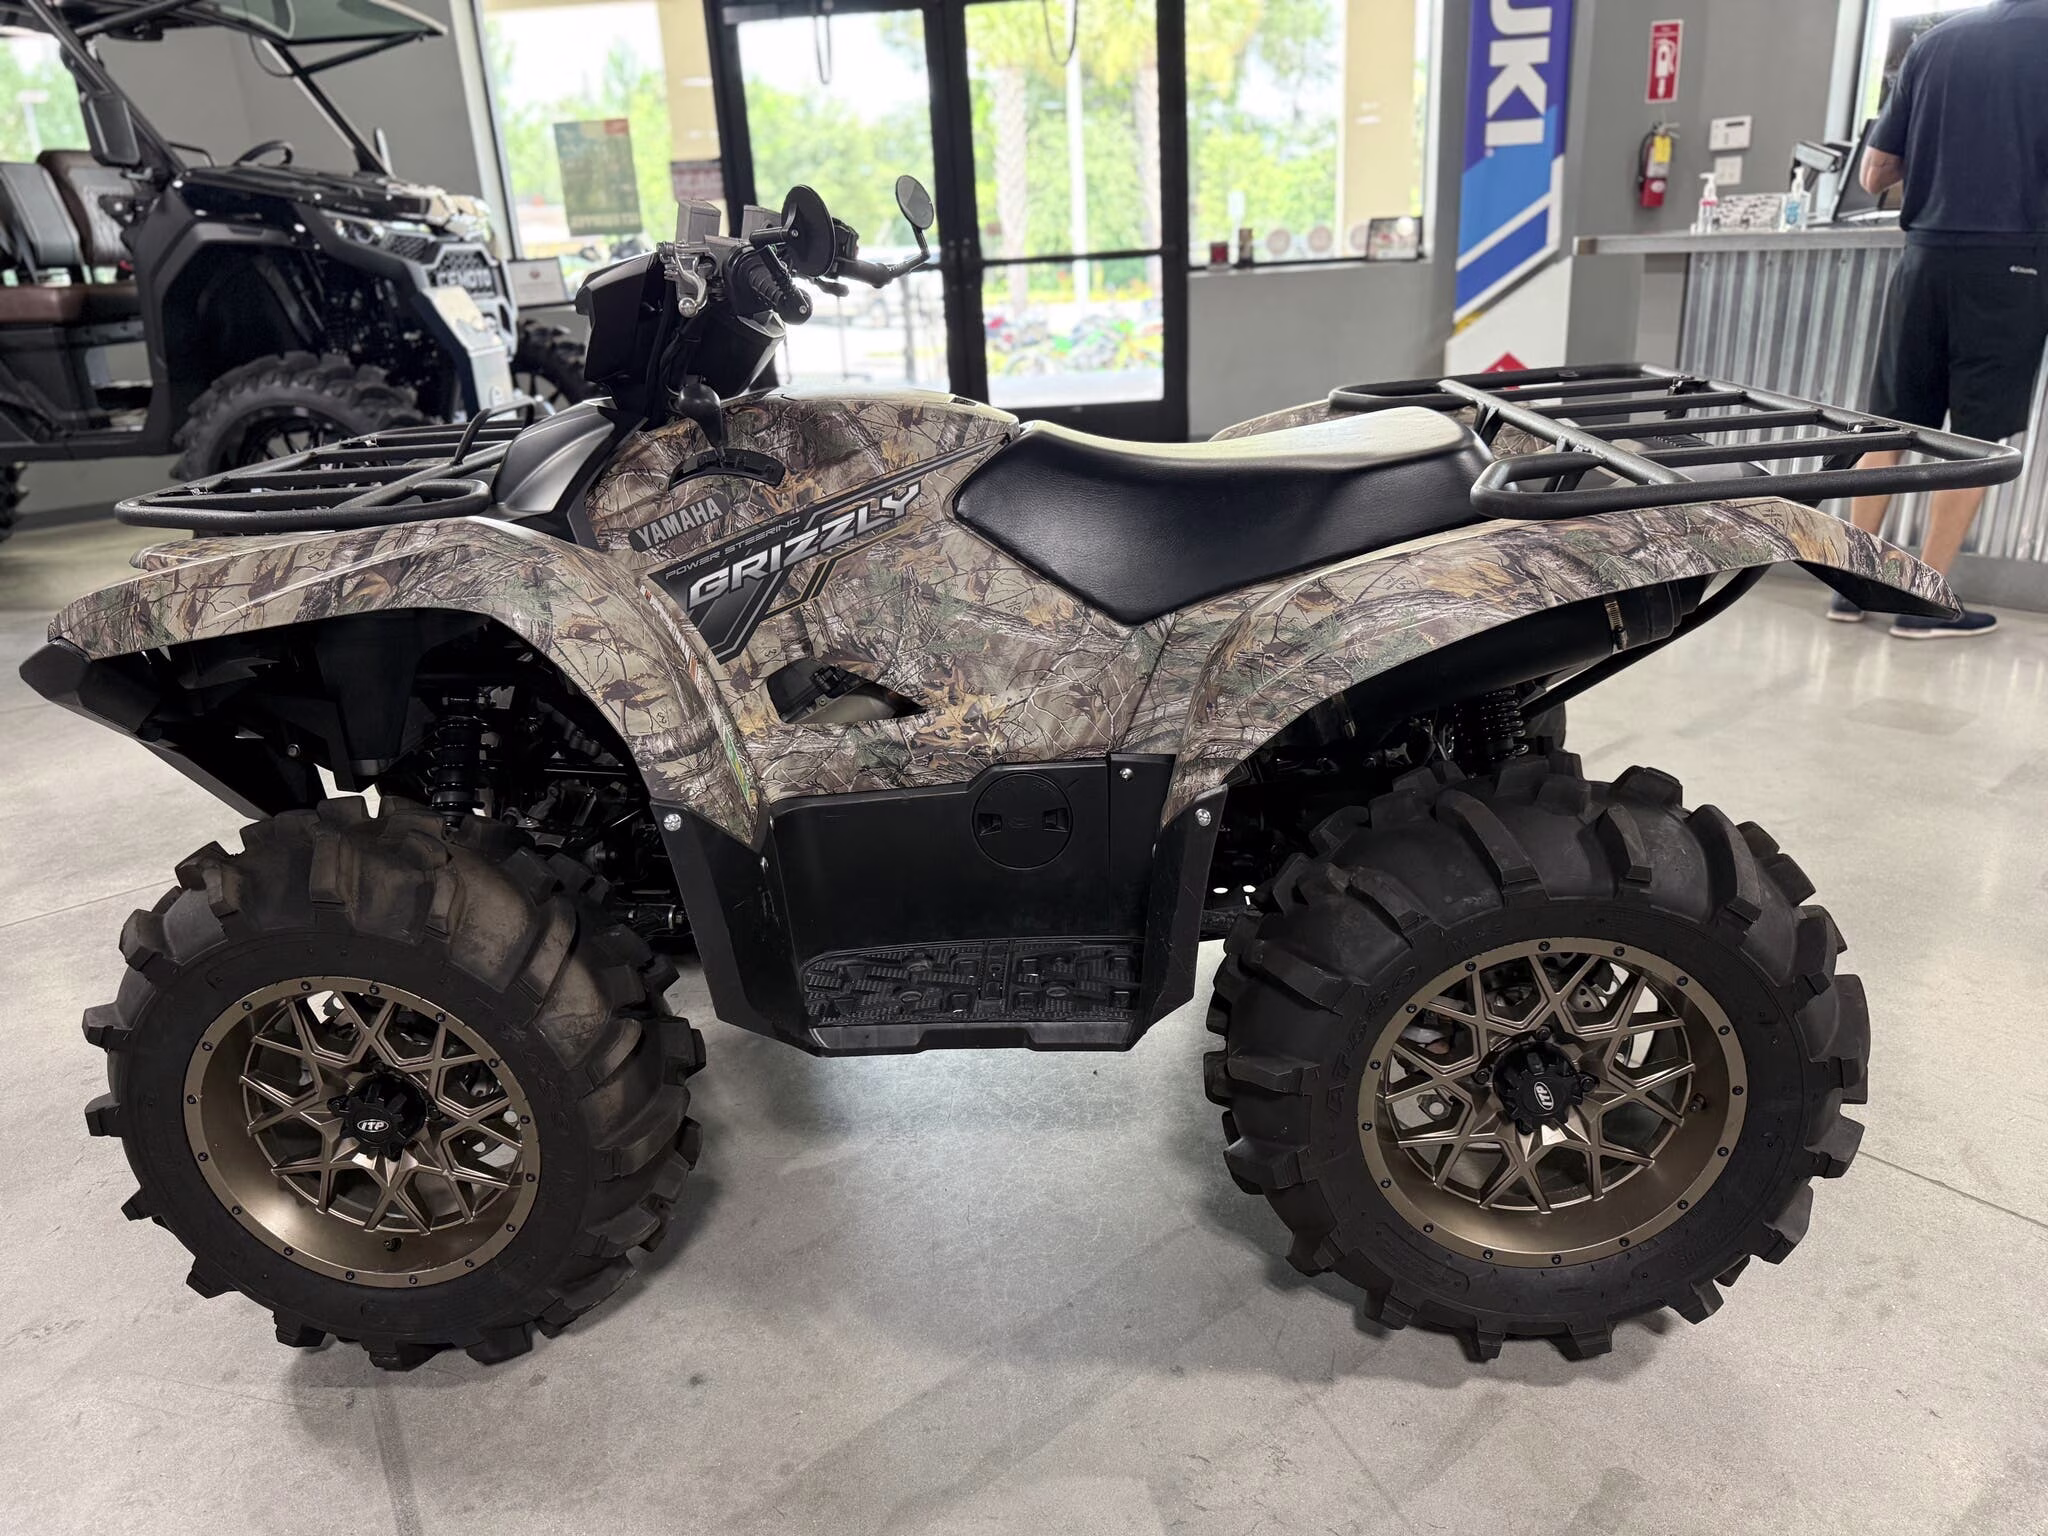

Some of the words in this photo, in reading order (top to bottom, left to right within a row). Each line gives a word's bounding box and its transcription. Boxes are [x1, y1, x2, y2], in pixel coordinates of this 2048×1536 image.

[636, 498, 723, 548] YAMAHA
[688, 482, 921, 609] GRIZZLY
[665, 551, 721, 580] POWER
[724, 517, 801, 555] STEERING
[1535, 1085, 1553, 1106] ITP
[361, 1121, 386, 1131] ITP
